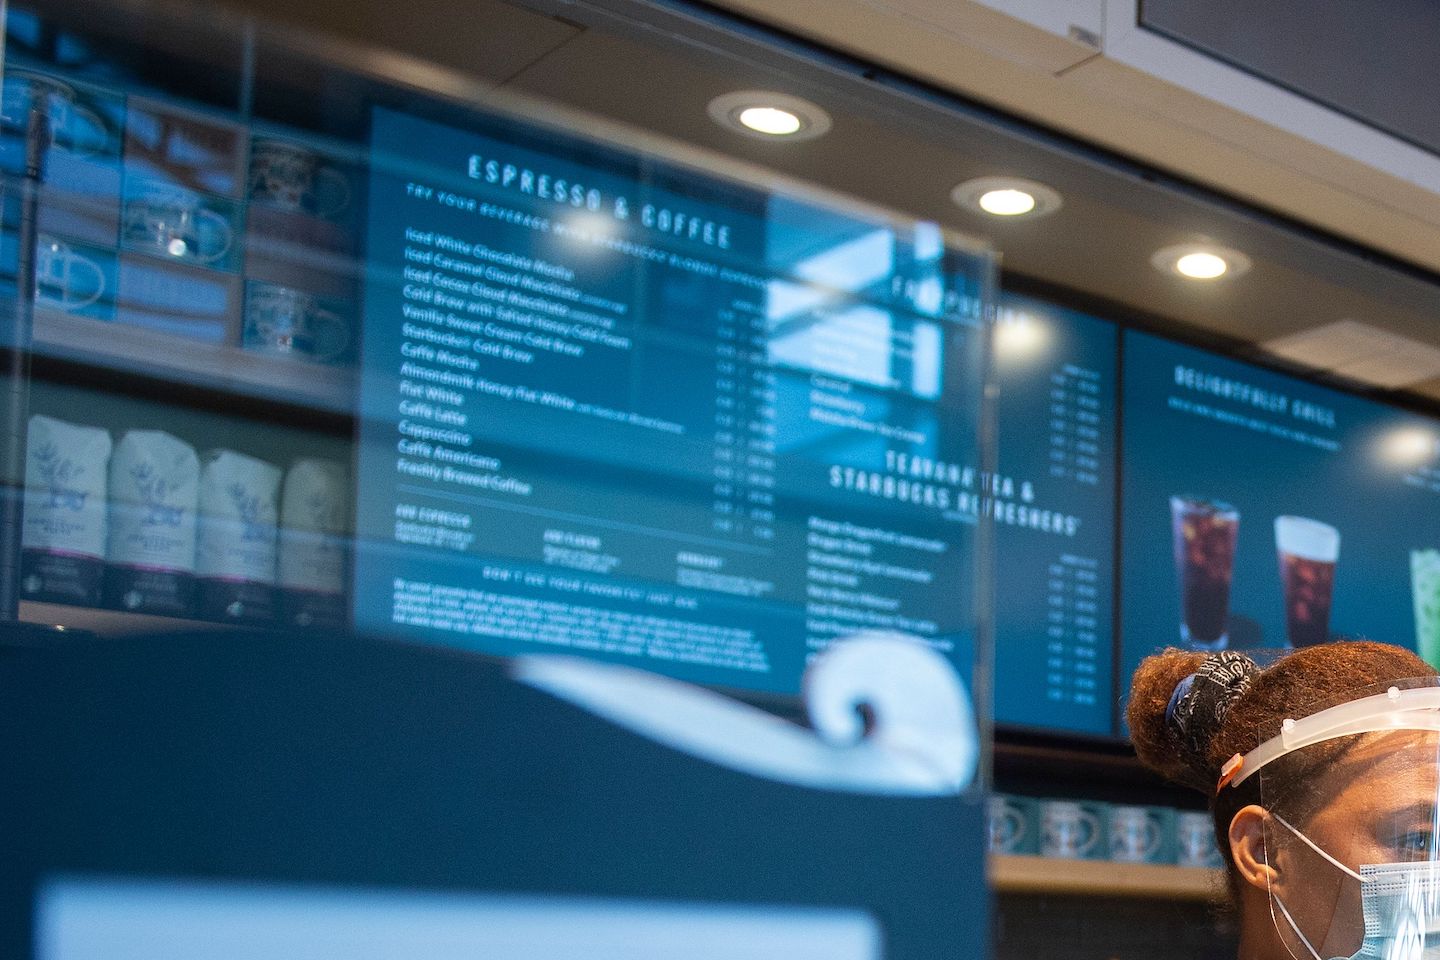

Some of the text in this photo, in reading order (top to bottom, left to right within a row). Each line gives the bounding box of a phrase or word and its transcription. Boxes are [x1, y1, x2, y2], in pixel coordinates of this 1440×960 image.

[468, 154, 601, 213] ESPRESSO
[614, 196, 630, 221] &
[641, 203, 731, 249] COFFEE
